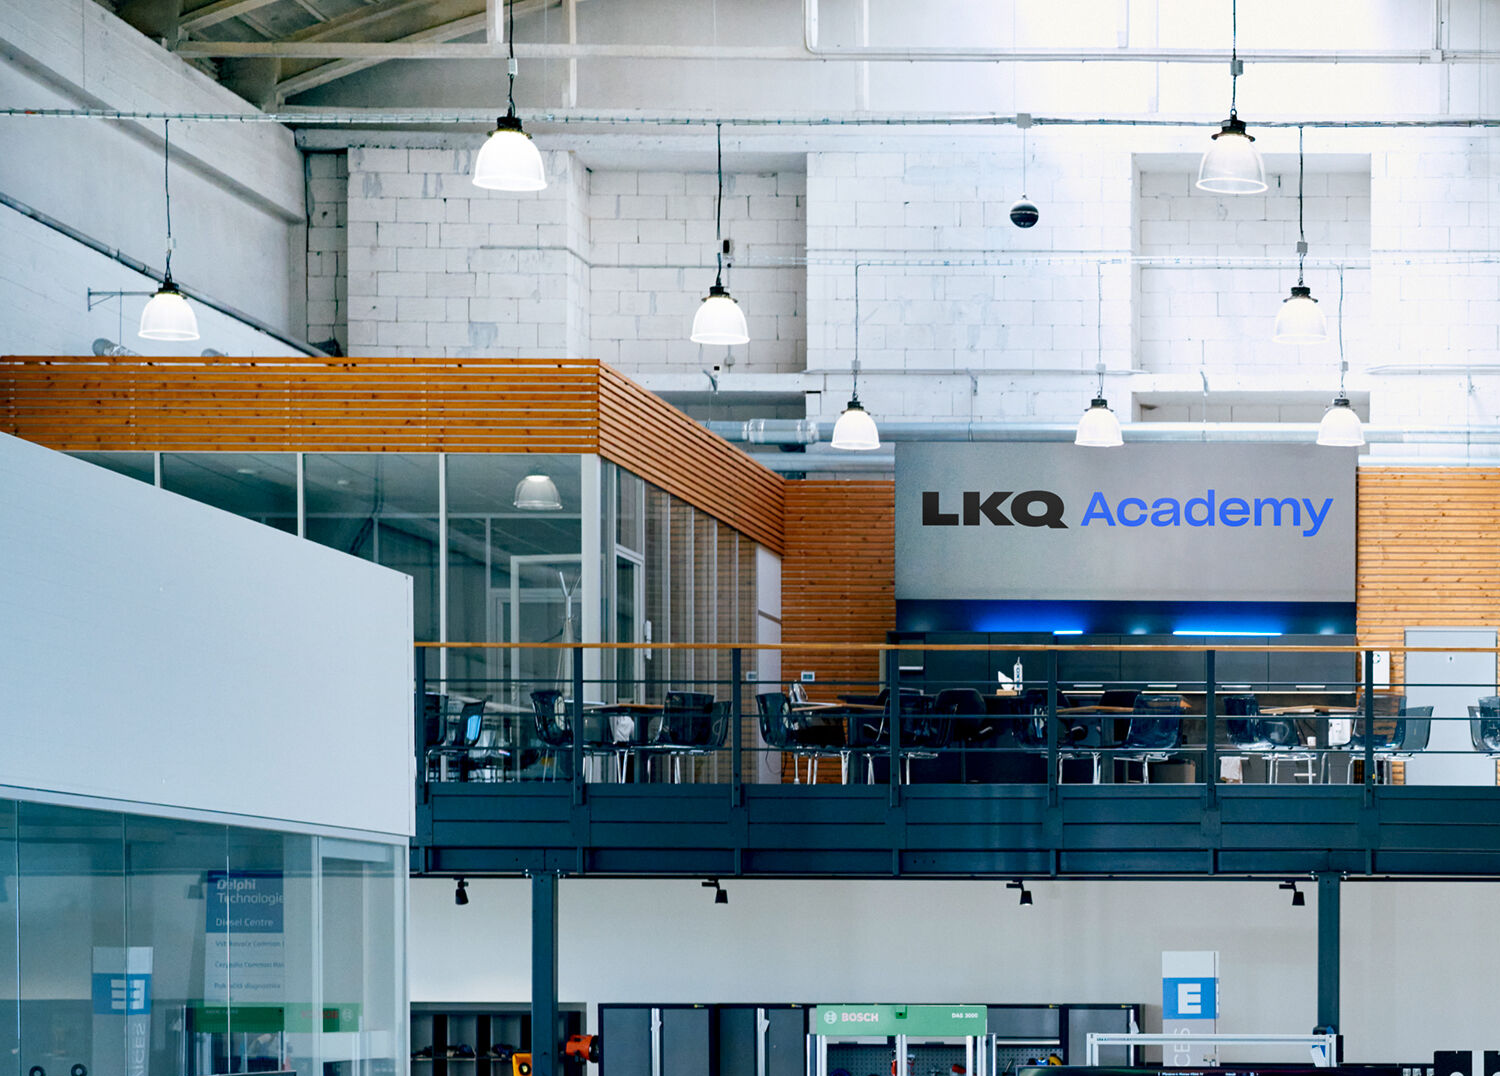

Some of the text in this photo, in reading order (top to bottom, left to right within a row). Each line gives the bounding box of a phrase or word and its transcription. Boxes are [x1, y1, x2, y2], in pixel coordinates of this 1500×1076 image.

[922, 489, 1334, 537] LKQ Academy
[244, 918, 274, 927] Centre
[1178, 984, 1201, 1014] E
[841, 1012, 879, 1022] BOSCH
